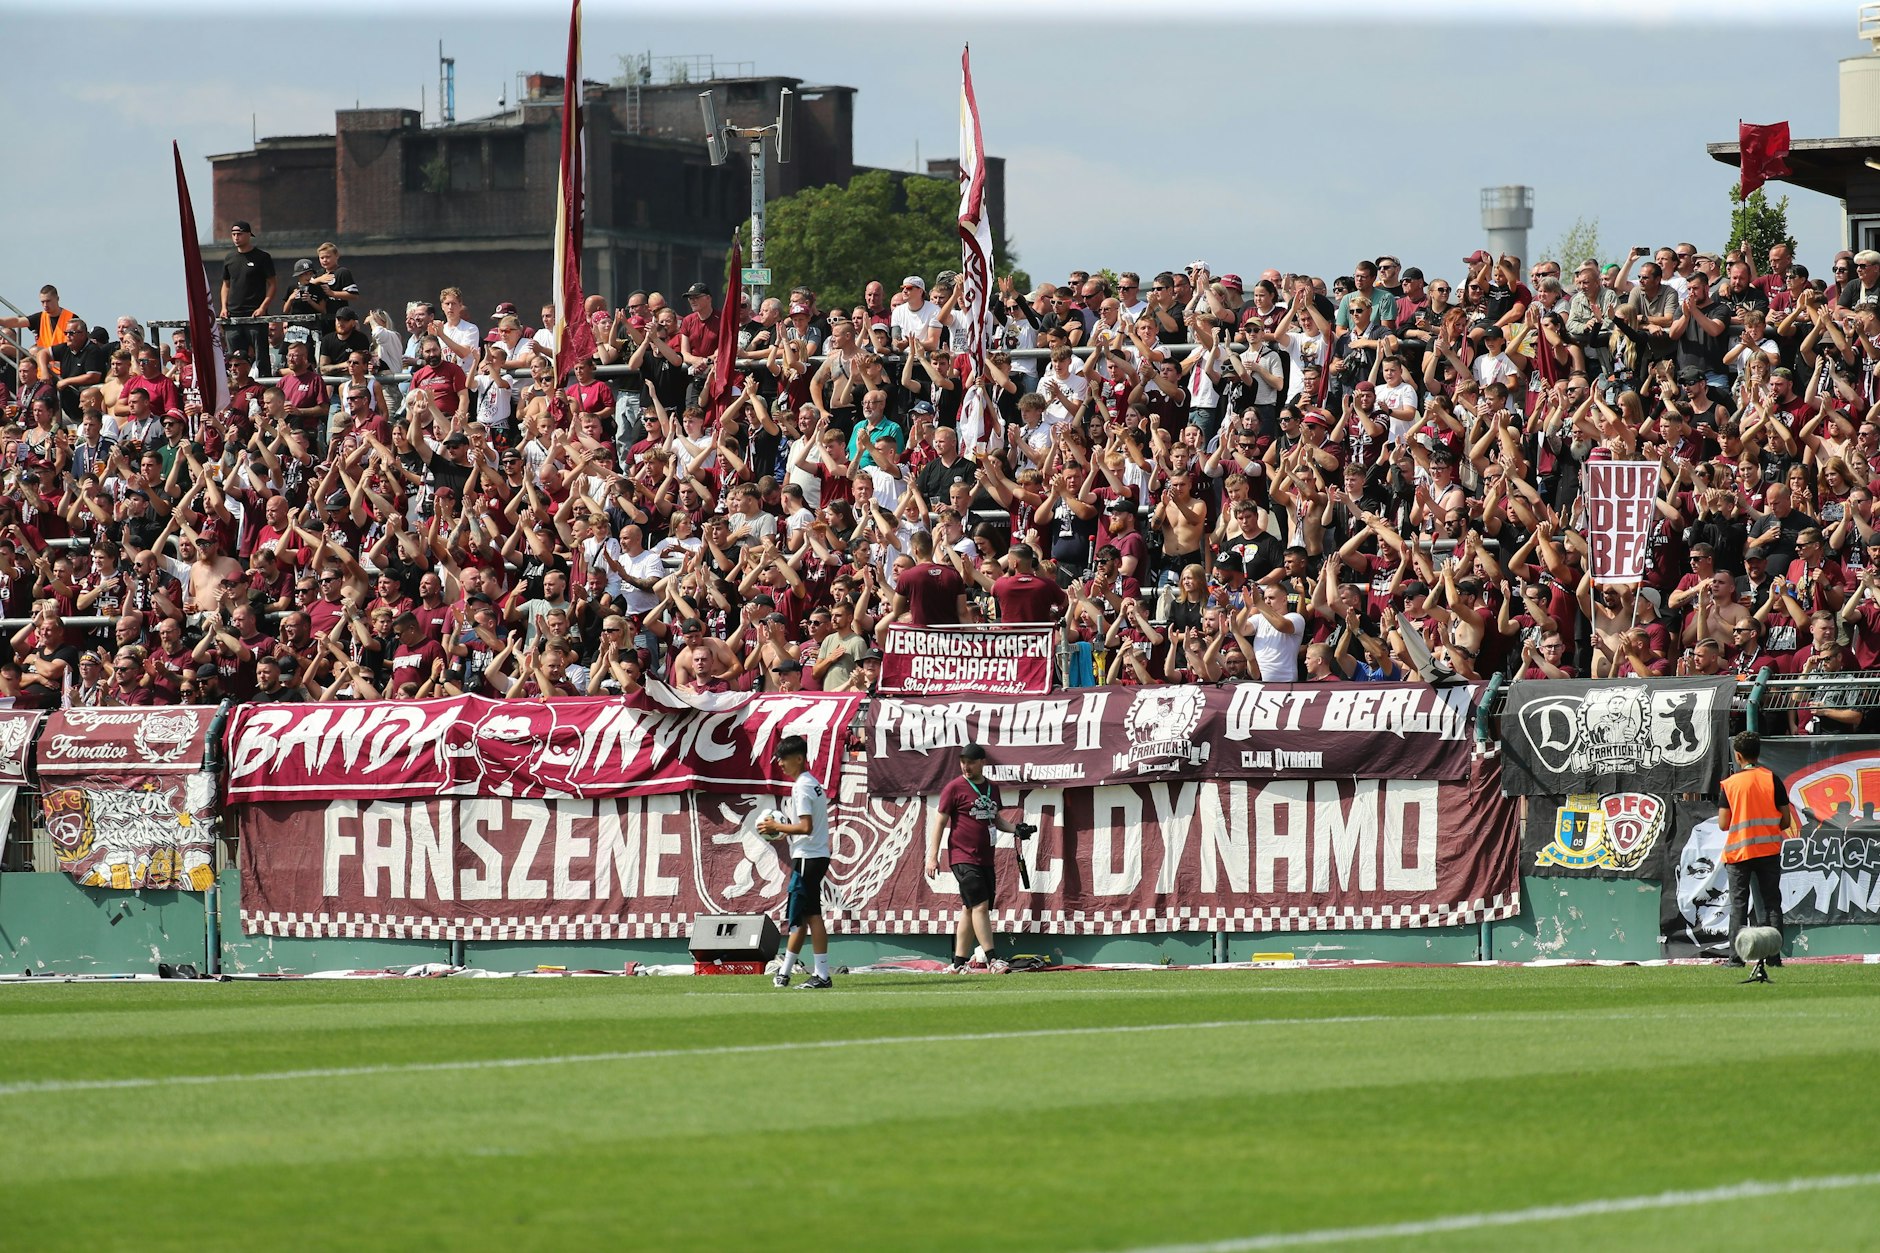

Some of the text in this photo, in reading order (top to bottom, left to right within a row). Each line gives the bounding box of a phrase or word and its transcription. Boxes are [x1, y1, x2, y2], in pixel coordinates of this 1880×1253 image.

[1591, 467, 1657, 498] NUR
[1591, 500, 1652, 532] DER
[1591, 534, 1646, 575] BFC
[885, 630, 1049, 658] VERBANDSSTRAFEN
[911, 656, 1018, 681] ABSCHAFFEN
[902, 677, 1026, 695] Strafen zünden nicht!
[1224, 683, 1479, 741] OST BERLIN
[574, 697, 839, 775] INVICTA
[873, 692, 1112, 759] FRAKTION-H
[46, 734, 128, 759] Fanatico
[231, 703, 464, 779] BANDA
[1131, 741, 1188, 761] FRAKTION-H
[1589, 745, 1642, 763] FRAKTION-H
[1023, 762, 1085, 782] FUSSBALL
[1241, 748, 1323, 771] CLUB DYNAMO
[1605, 795, 1655, 820] BFC
[1092, 780, 1439, 897] DYNAMO
[1562, 820, 1600, 833] SVE
[322, 794, 681, 900] FANSZENE
[1573, 838, 1584, 847] 05
